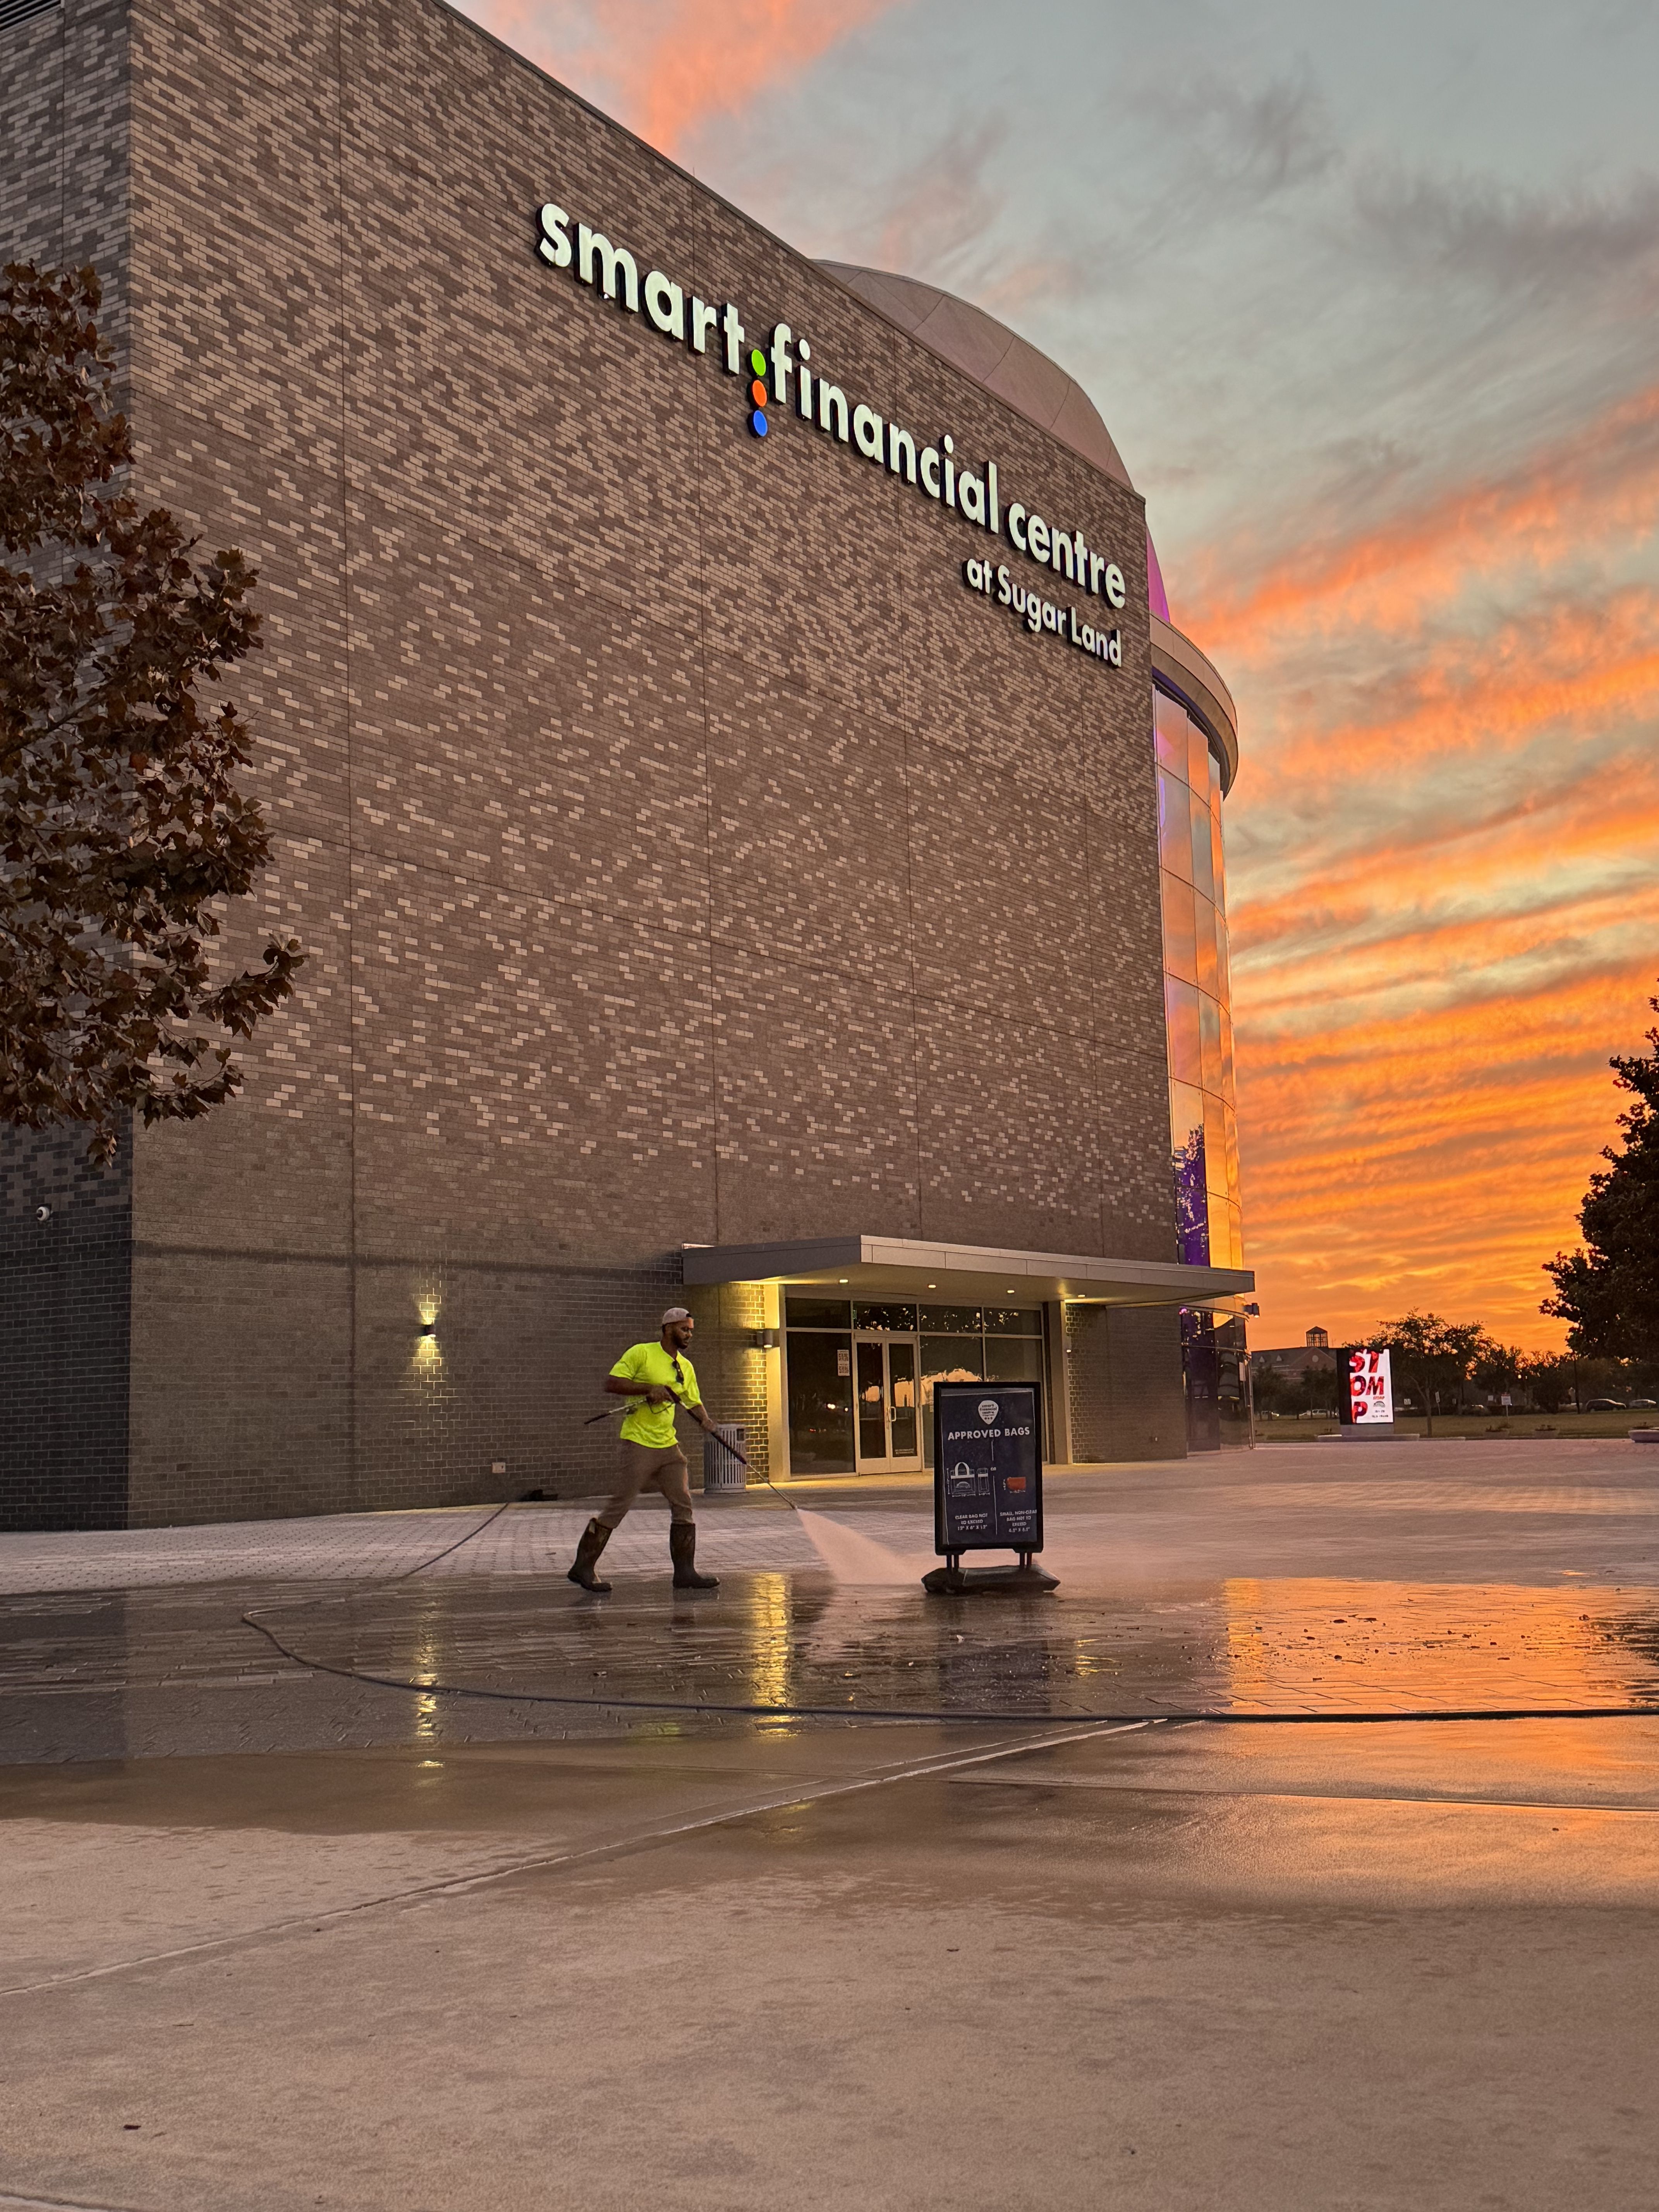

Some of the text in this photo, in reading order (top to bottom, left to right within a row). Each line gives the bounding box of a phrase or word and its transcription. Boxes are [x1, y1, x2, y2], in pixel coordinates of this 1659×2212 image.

[538, 203, 1126, 608] smart financial centre
[965, 558, 1121, 667] at Sugar Land
[948, 1427, 1030, 1440] APPROVED BAGS
